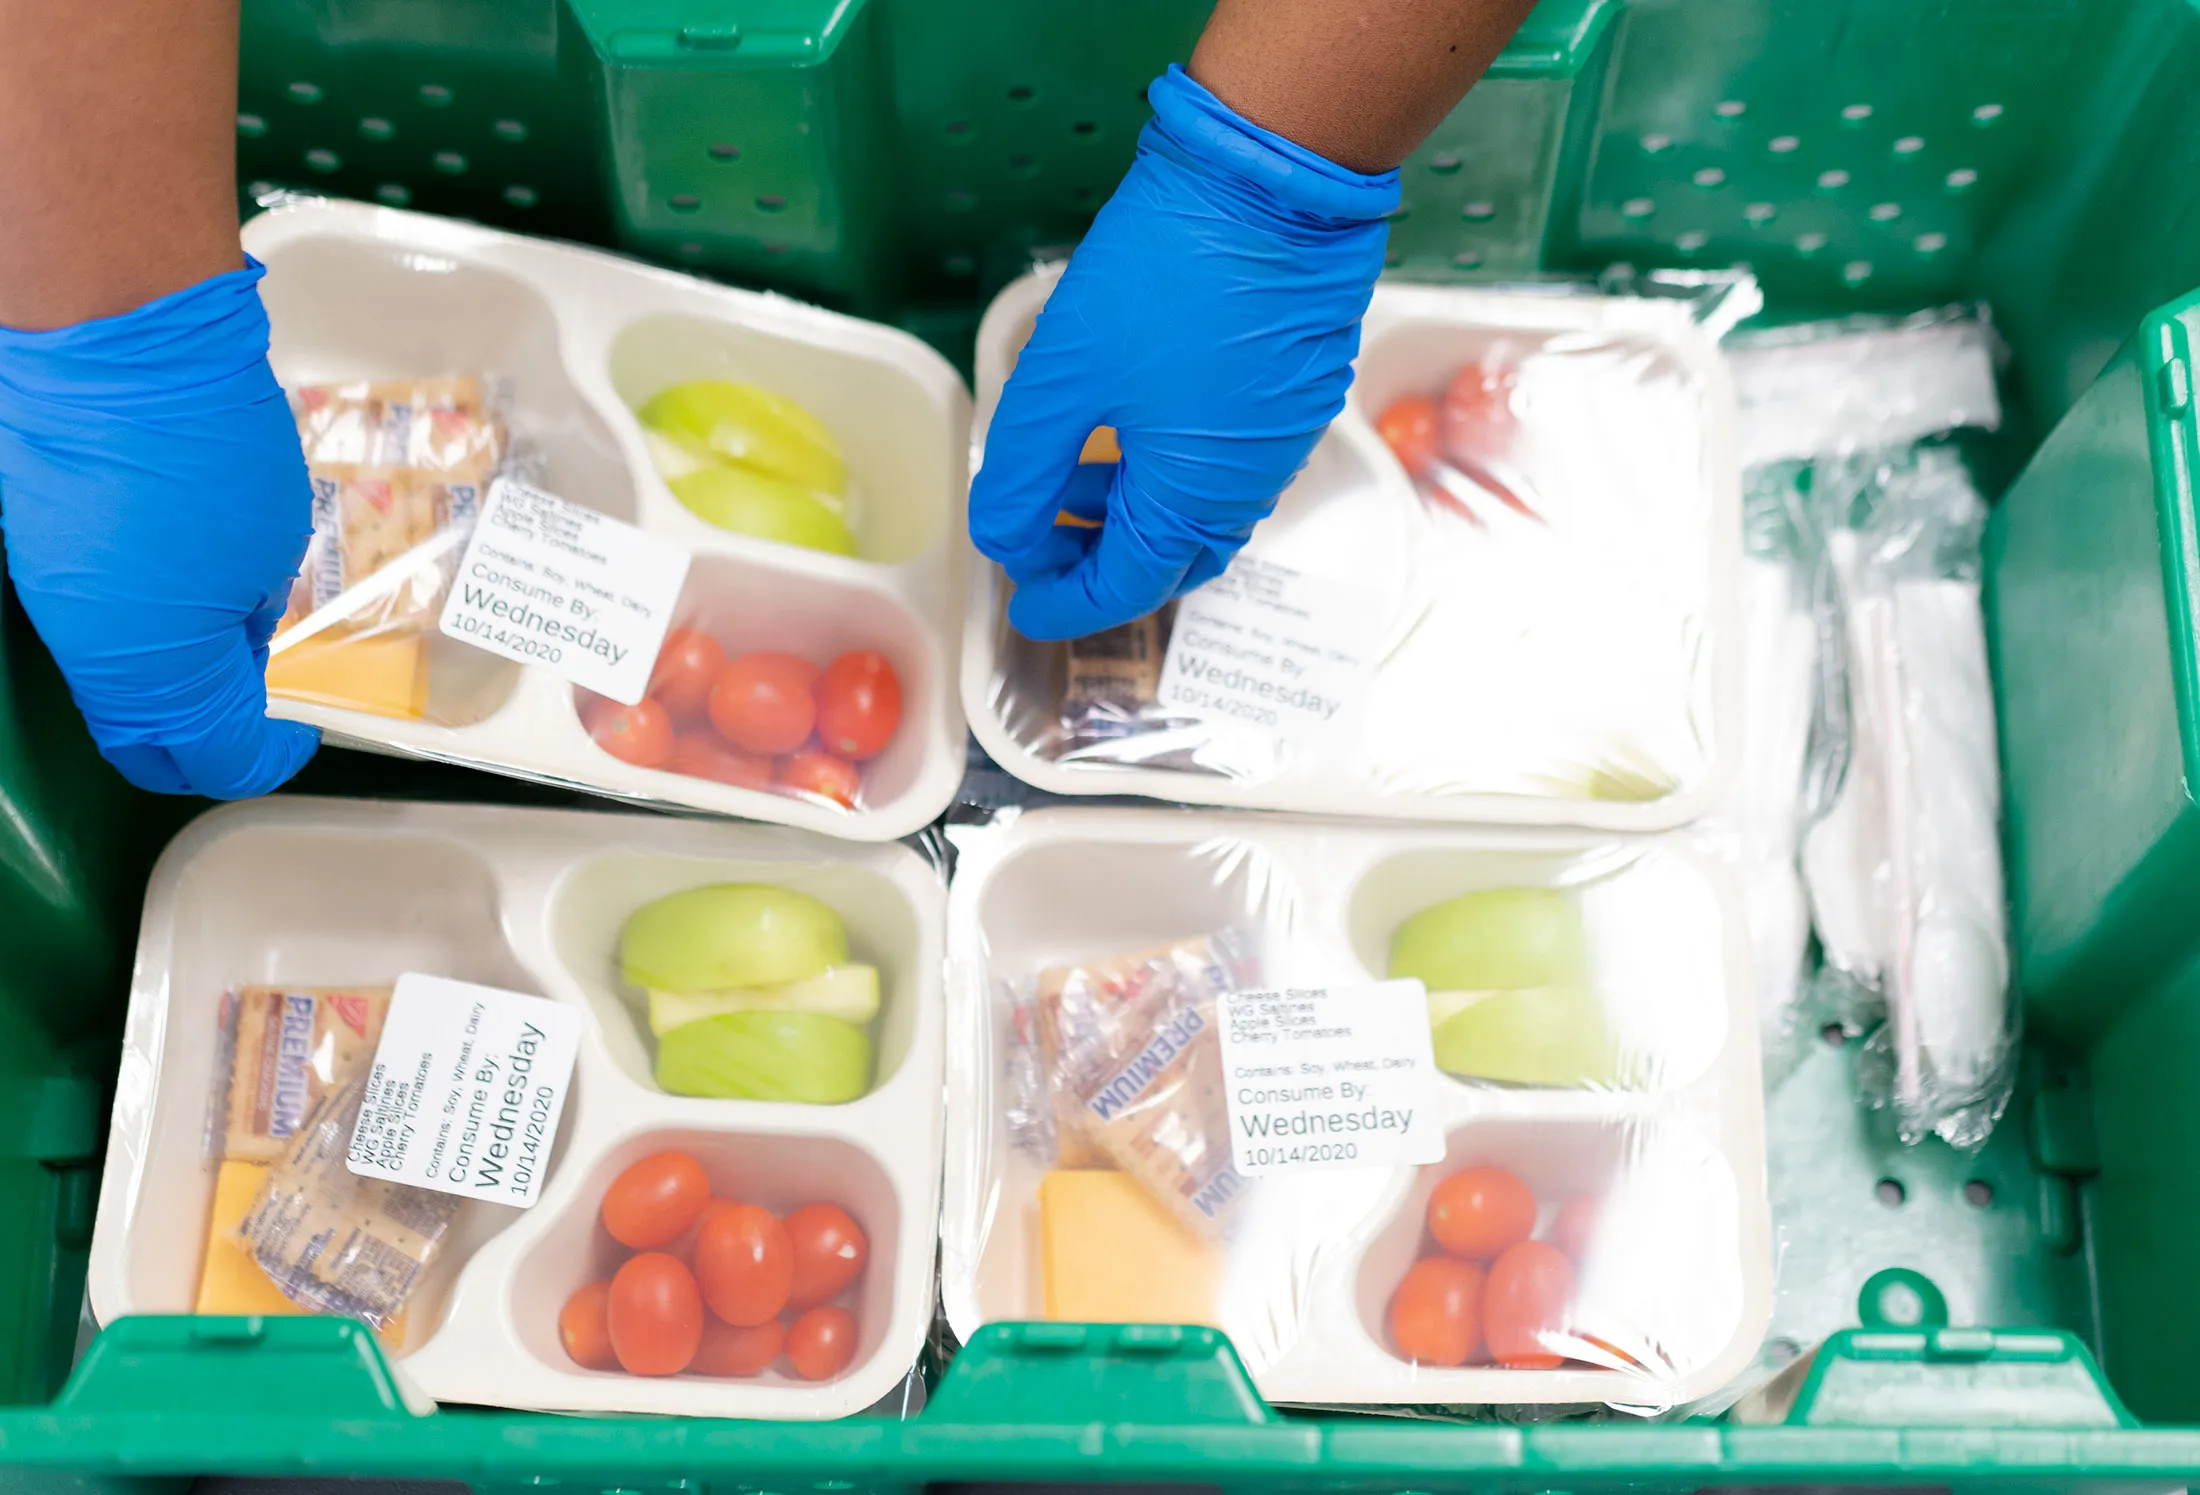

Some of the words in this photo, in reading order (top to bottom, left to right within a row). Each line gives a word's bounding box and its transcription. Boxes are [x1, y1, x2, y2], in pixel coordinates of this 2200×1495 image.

[471, 562, 564, 608] Consume
[451, 612, 562, 663] 10/14/2020
[464, 584, 629, 666] Wednesday
[1183, 630, 1273, 668] Consume
[1171, 685, 1278, 725] 10/14/2020
[1178, 653, 1340, 720] Wednesday
[1227, 991, 1280, 1004] Cheese
[1286, 988, 1327, 1000] Slices
[1228, 1005, 1254, 1017] WG
[1260, 1002, 1314, 1015] Saltines
[1231, 1017, 1269, 1031] Apple
[1275, 1015, 1316, 1027] Slices
[1091, 1007, 1205, 1122] PREMIUM
[1231, 1031, 1277, 1044] Cherry
[1282, 1027, 1352, 1039] Tomatoes
[1383, 1057, 1415, 1069] Dairy
[271, 996, 314, 1135] PREMIUM
[426, 1120, 452, 1178] Contains:
[444, 1087, 462, 1115] Soy,
[453, 1040, 475, 1081] Wheat,
[465, 1001, 485, 1035] Dairy
[1238, 1085, 1333, 1105] Consume
[348, 1109, 372, 1162] Cheese
[364, 1064, 386, 1105] Slices
[360, 1139, 378, 1164] WG
[371, 1080, 396, 1135] Saltines
[376, 1128, 397, 1169] Apple
[388, 1083, 409, 1124] Slices
[390, 1124, 416, 1170] Cherry
[403, 1052, 433, 1120] Tomatoes
[449, 1090, 488, 1183] Consume
[476, 1054, 500, 1084] By:
[475, 1022, 545, 1187] Wednesday
[1240, 1106, 1413, 1137] Wednesday
[512, 1087, 554, 1196] 10/14/2020
[1246, 1143, 1357, 1166] 10/14/2020
